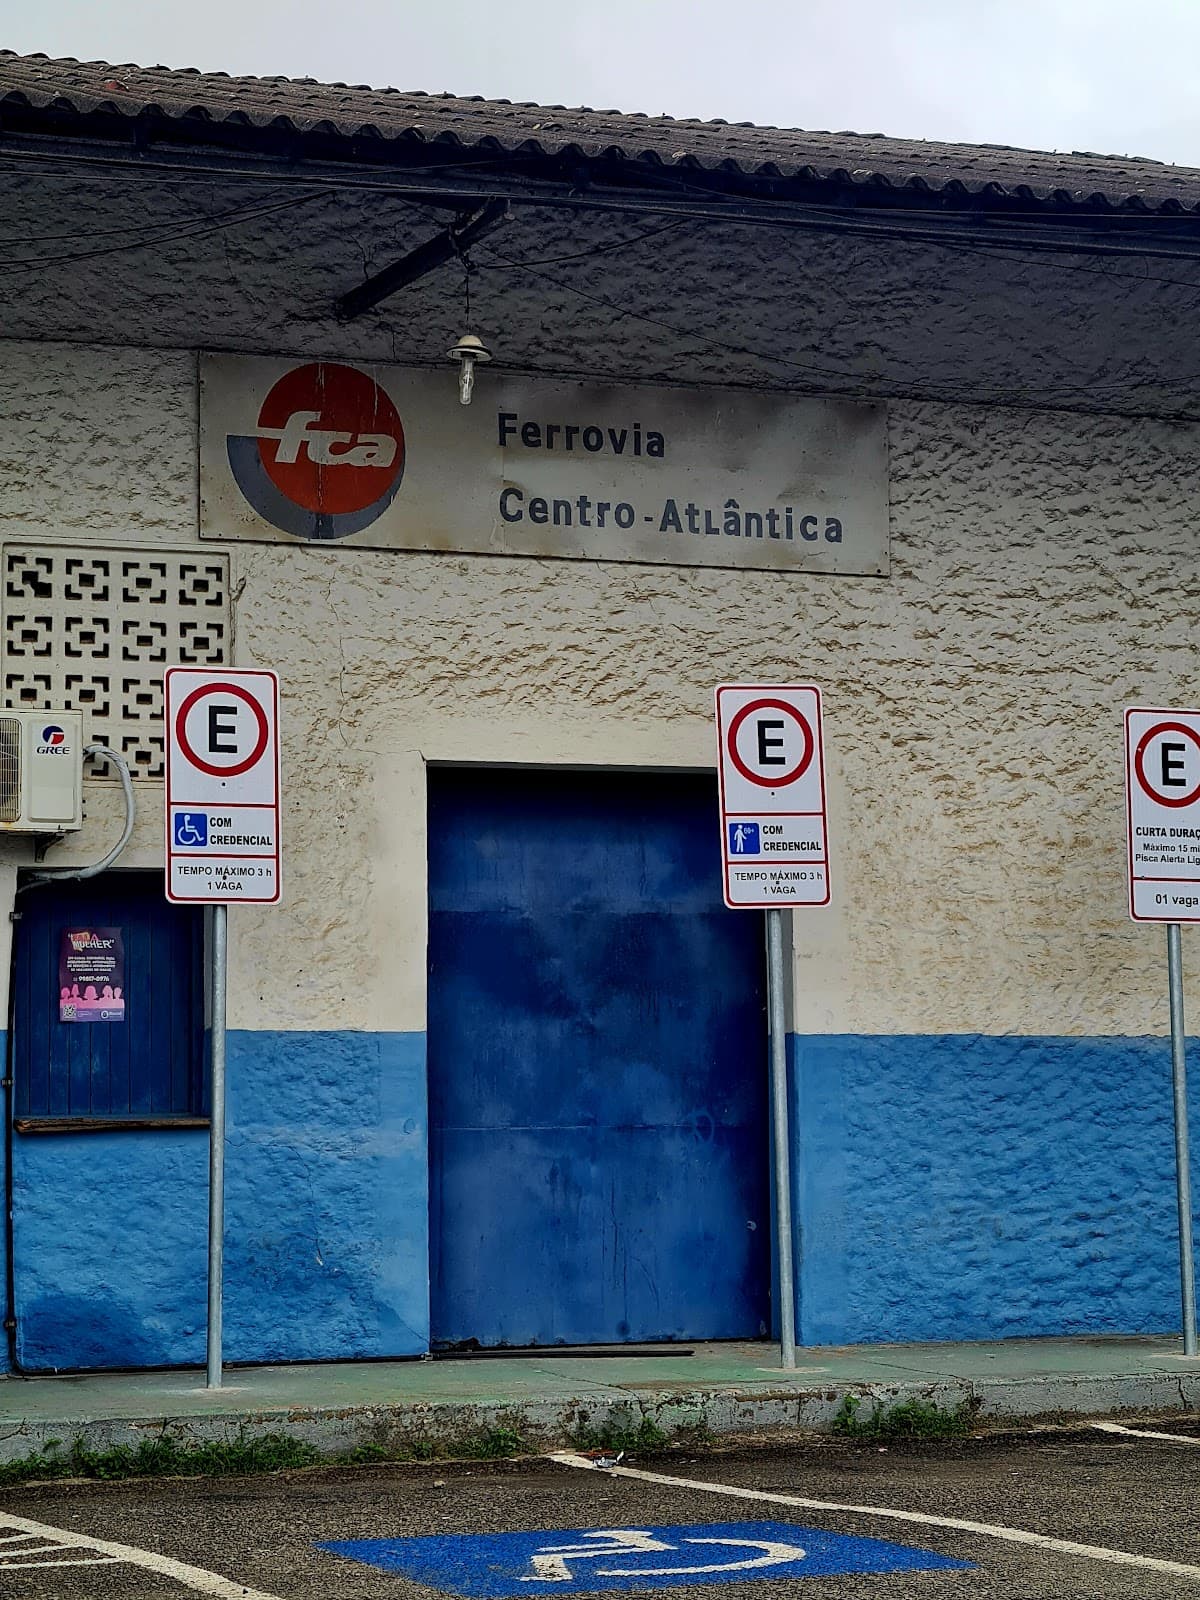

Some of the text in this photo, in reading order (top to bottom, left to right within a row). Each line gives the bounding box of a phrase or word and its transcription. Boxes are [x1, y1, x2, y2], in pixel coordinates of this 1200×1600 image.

[256, 410, 398, 468] fca
[498, 412, 665, 458] Ferrovia
[208, 705, 238, 754] E
[757, 719, 786, 765] E
[36, 746, 71, 755] GREE
[1161, 742, 1187, 787] E
[209, 817, 232, 828] COM
[762, 825, 784, 835] COM
[1135, 826, 1167, 837] CURTA
[209, 835, 273, 846] CREDENCIAL
[763, 841, 822, 851] CREDENCIAL
[1143, 843, 1176, 852] Máximo
[1178, 844, 1188, 853] 15
[1135, 853, 1159, 863] Pisca
[1160, 854, 1185, 864] Alerta
[177, 864, 272, 877] TEMPO MÁXIMO 3 h
[735, 869, 823, 881] TEMPO MÁXIMO 3 h
[207, 881, 243, 891] 1 VAGA
[763, 886, 797, 895] 1 VAGA
[1155, 893, 1199, 908] 01 vaga
